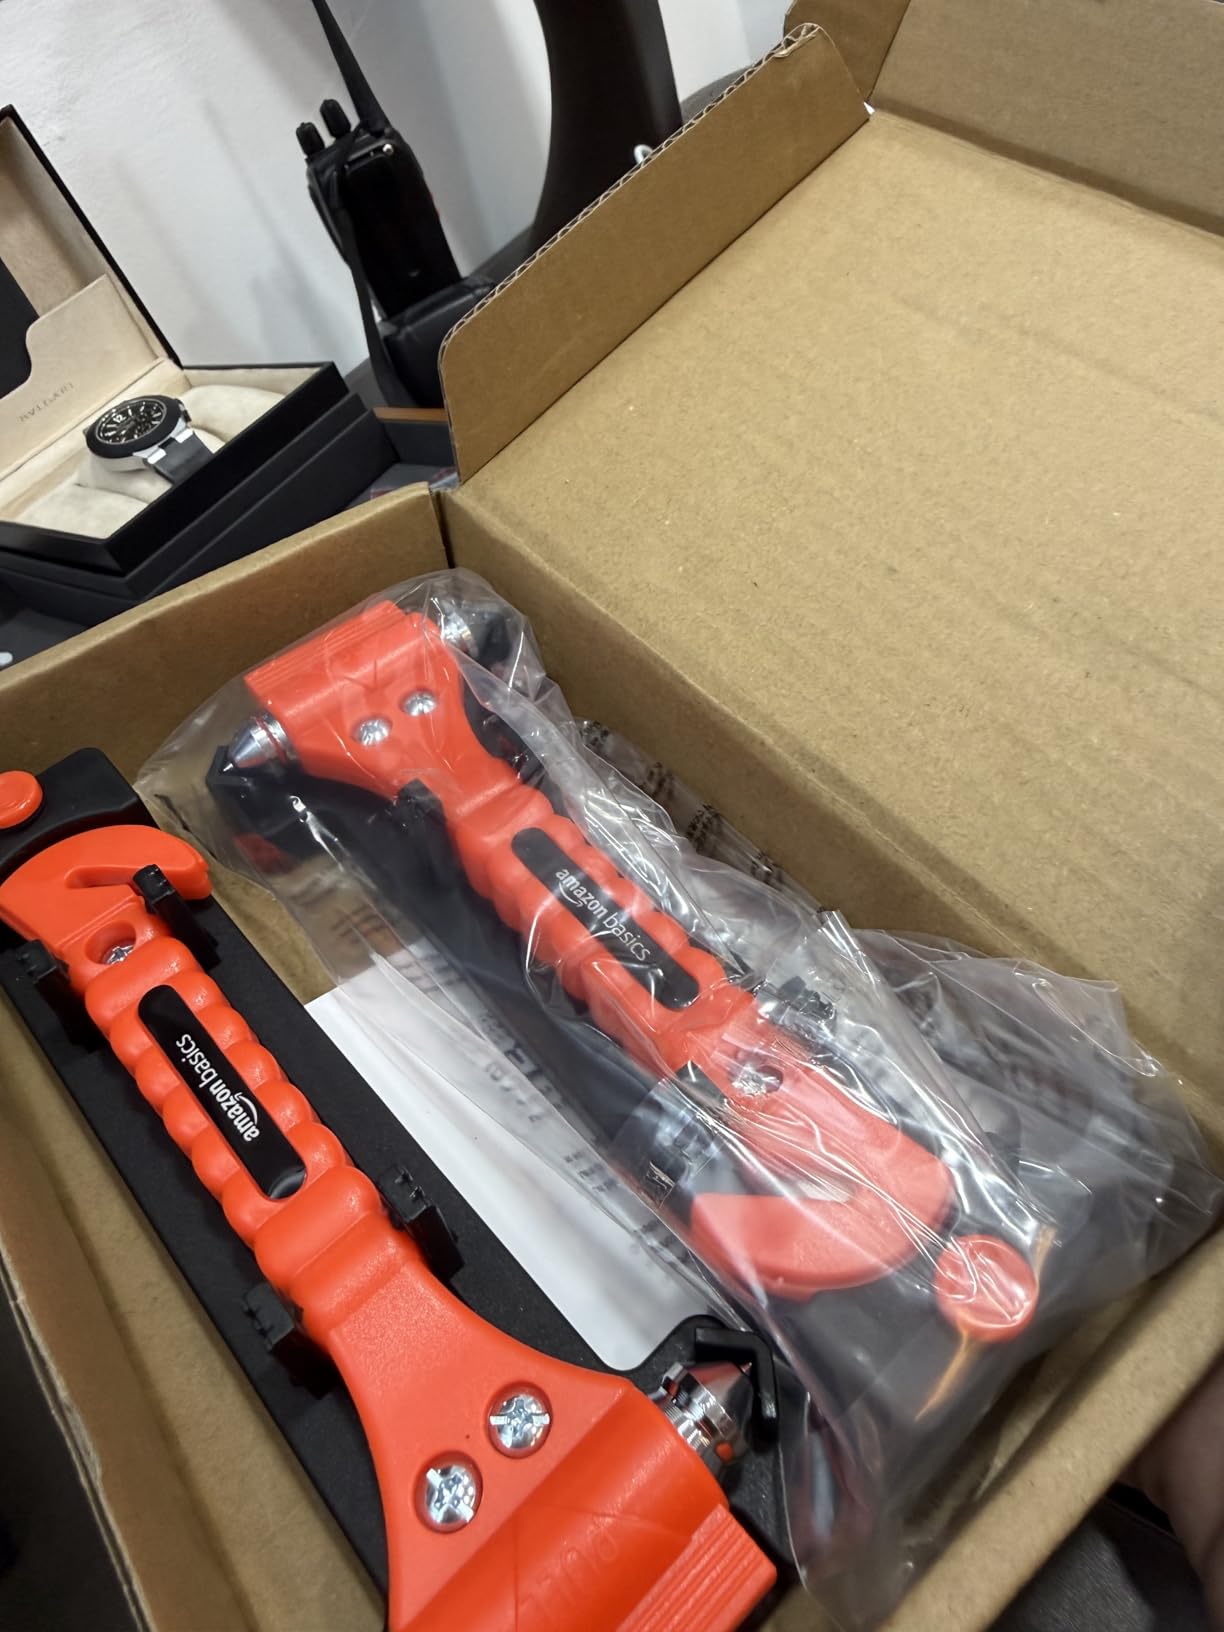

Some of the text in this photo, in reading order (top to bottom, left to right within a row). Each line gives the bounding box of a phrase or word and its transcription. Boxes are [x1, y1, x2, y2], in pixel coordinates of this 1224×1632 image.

[556, 869, 651, 961] amazon basics
[176, 1033, 260, 1141] amazon basics
